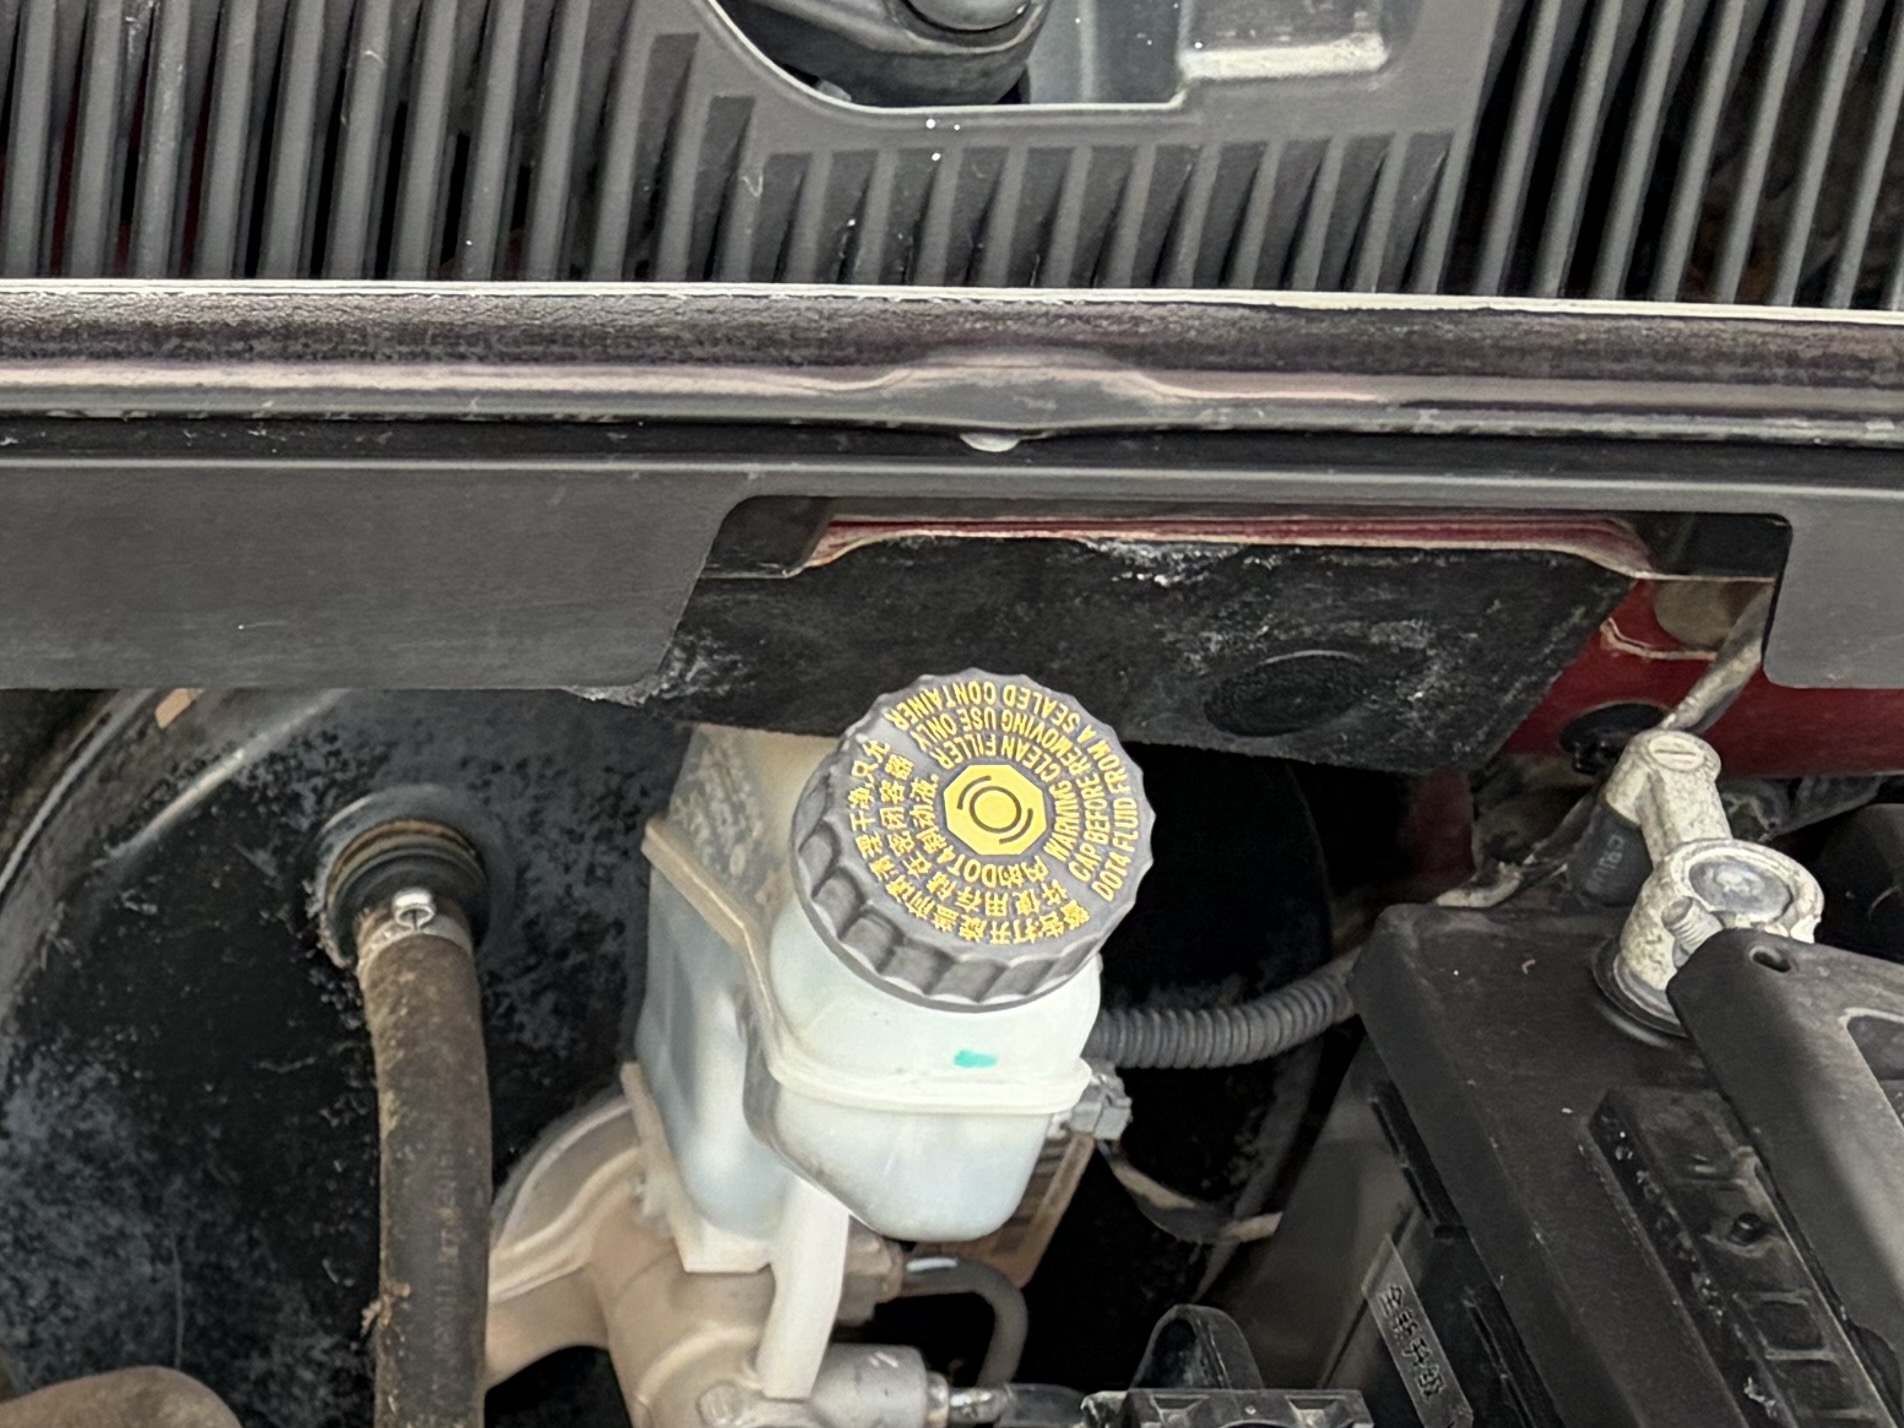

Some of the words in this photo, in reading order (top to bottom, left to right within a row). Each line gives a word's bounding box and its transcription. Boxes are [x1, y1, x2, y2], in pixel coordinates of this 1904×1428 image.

[884, 680, 997, 731] CONTAINER
[957, 707, 997, 731] USE
[1003, 684, 1081, 733] SEALED
[910, 711, 957, 751] ONLY
[929, 734, 997, 770] FILLER
[1001, 709, 1088, 775] REMOVING
[1077, 724, 1097, 743] A
[1001, 735, 1062, 783] CLEAN
[1087, 739, 1131, 795] FROM
[1044, 780, 1080, 862] WARNING
[1076, 773, 1110, 849] BEFORE
[1112, 797, 1139, 852] FLUID
[1068, 839, 1103, 883] CAP
[1091, 852, 1132, 901] DOT4
